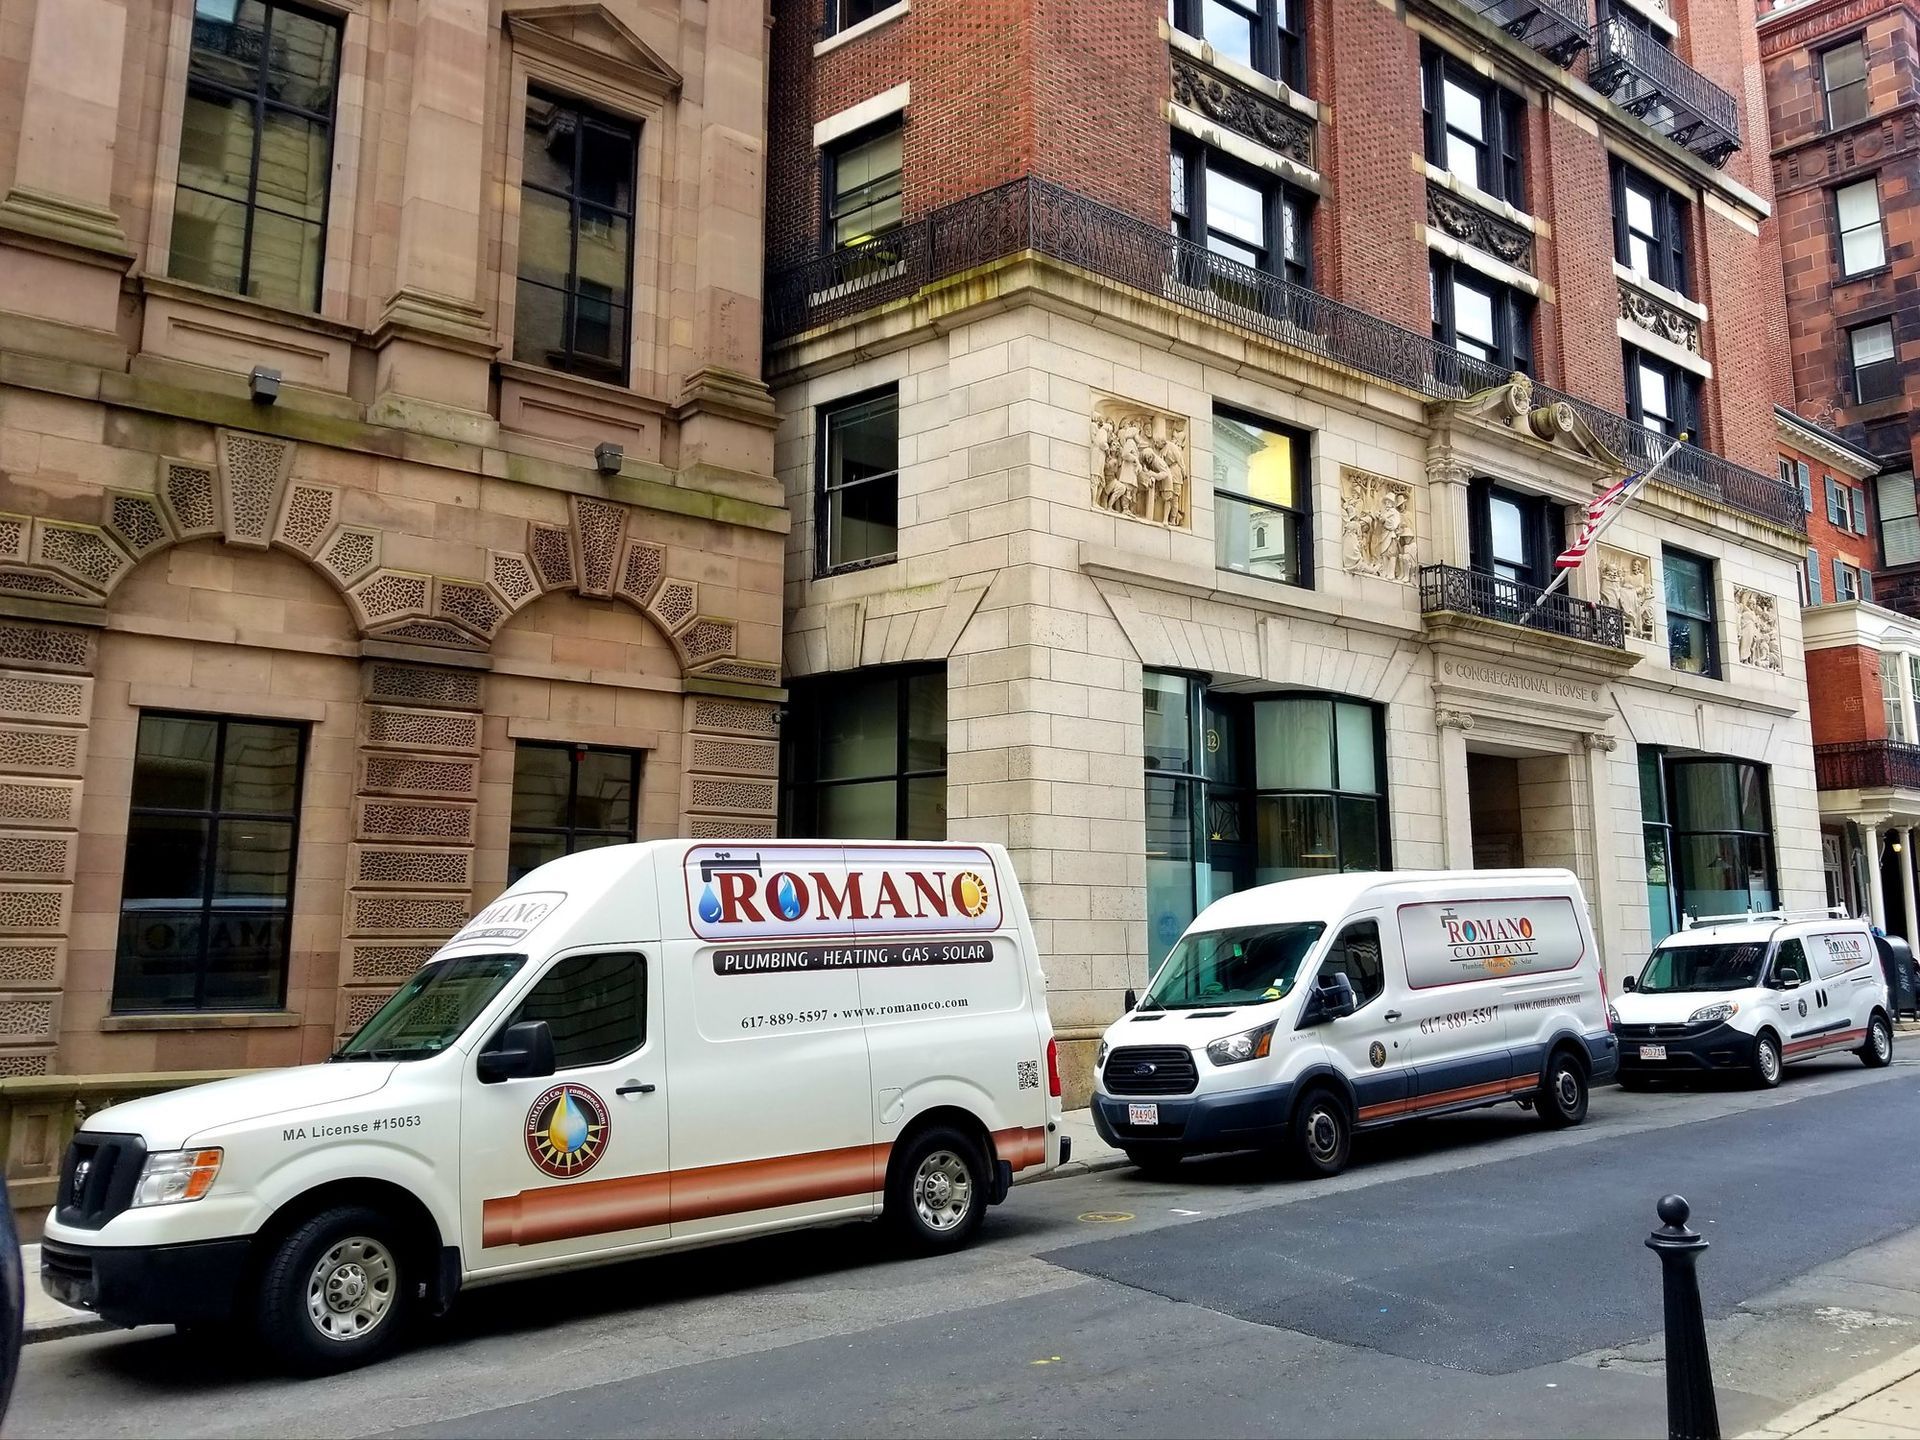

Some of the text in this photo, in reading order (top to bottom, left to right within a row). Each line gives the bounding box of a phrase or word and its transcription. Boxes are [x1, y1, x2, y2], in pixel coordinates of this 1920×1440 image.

[1456, 663, 1552, 694] CONGREGATIONAL
[713, 869, 989, 924] ROMANO
[1446, 917, 1533, 943] ROMANO
[724, 945, 985, 971] PLUMBING HEATING GAS SOLAR
[1453, 941, 1533, 958] COMPANY
[741, 998, 968, 1029] 617-889-5597 www.romanoco.com
[1420, 993, 1581, 1035] 617-889-5597 www.romanoco.com
[528, 1095, 550, 1131] ROMANO
[569, 1088, 606, 1125] romanoco.com
[283, 1115, 421, 1141] MA License #15053
